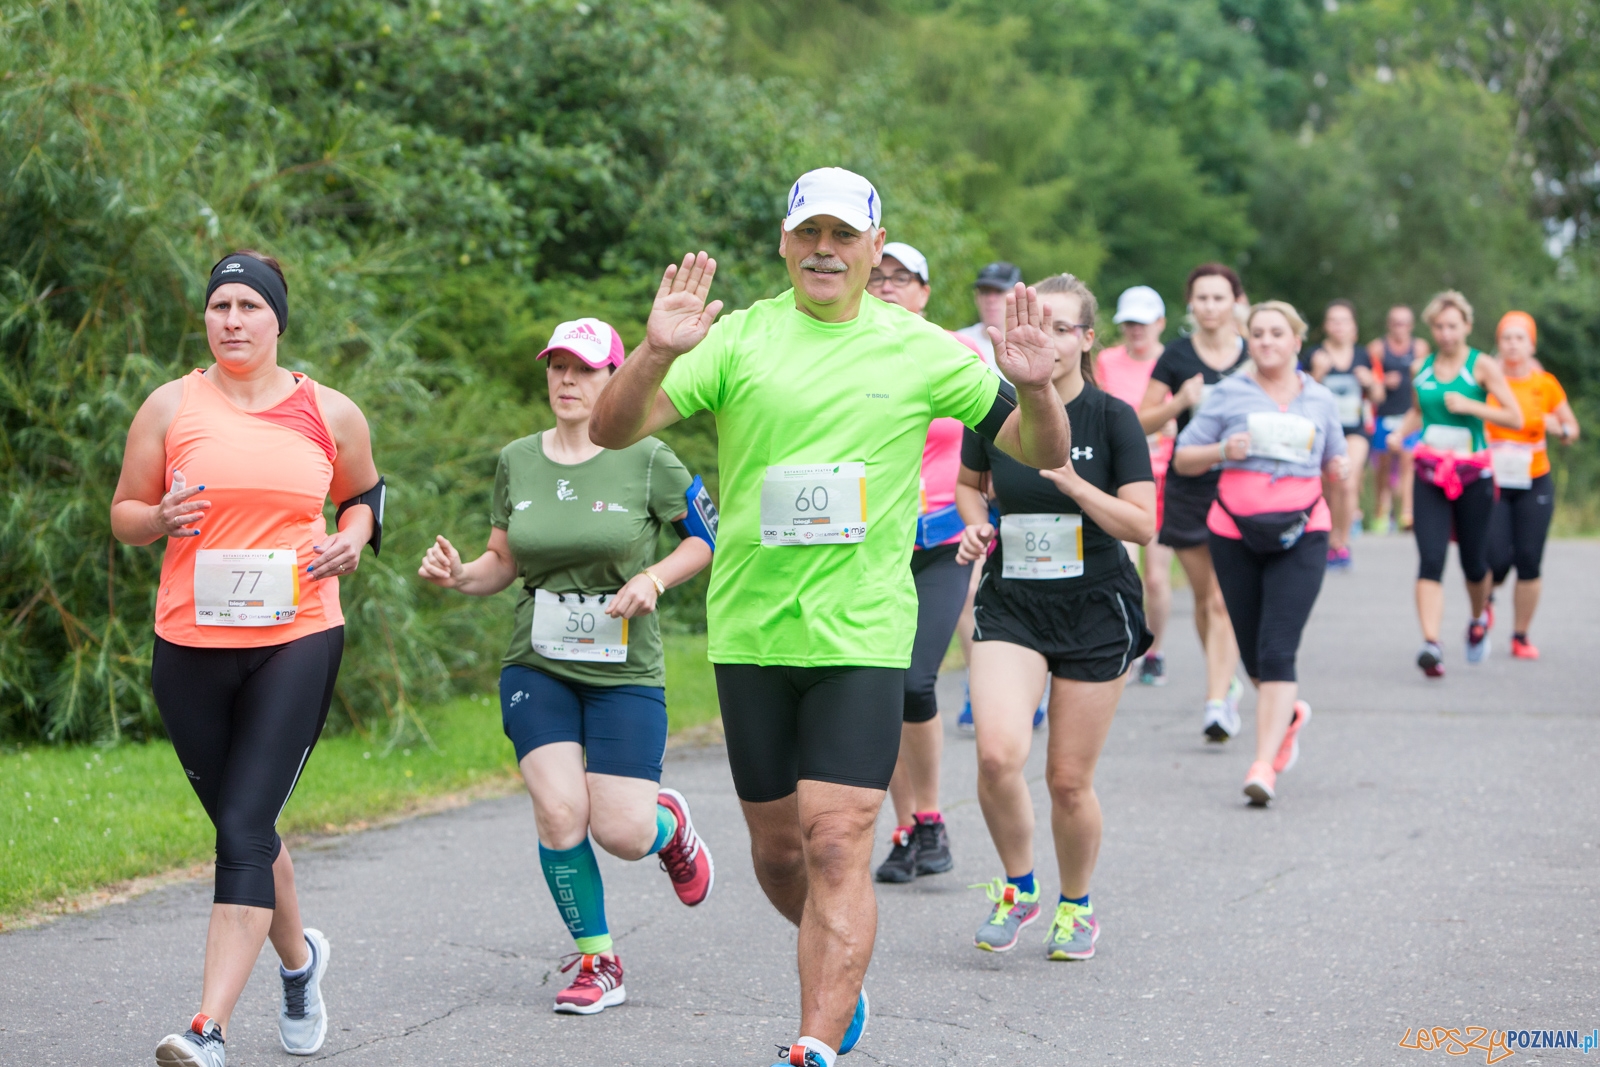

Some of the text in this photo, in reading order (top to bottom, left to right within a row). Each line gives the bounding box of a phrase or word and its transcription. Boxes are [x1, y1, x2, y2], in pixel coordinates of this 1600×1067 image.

[564, 332, 602, 345] adidas
[795, 486, 828, 512] 60
[851, 527, 865, 535] mjp
[1025, 531, 1051, 552] 86
[231, 570, 263, 594] 77
[281, 609, 296, 617] mjp
[566, 611, 595, 633] 50
[549, 865, 584, 932] kalenji
